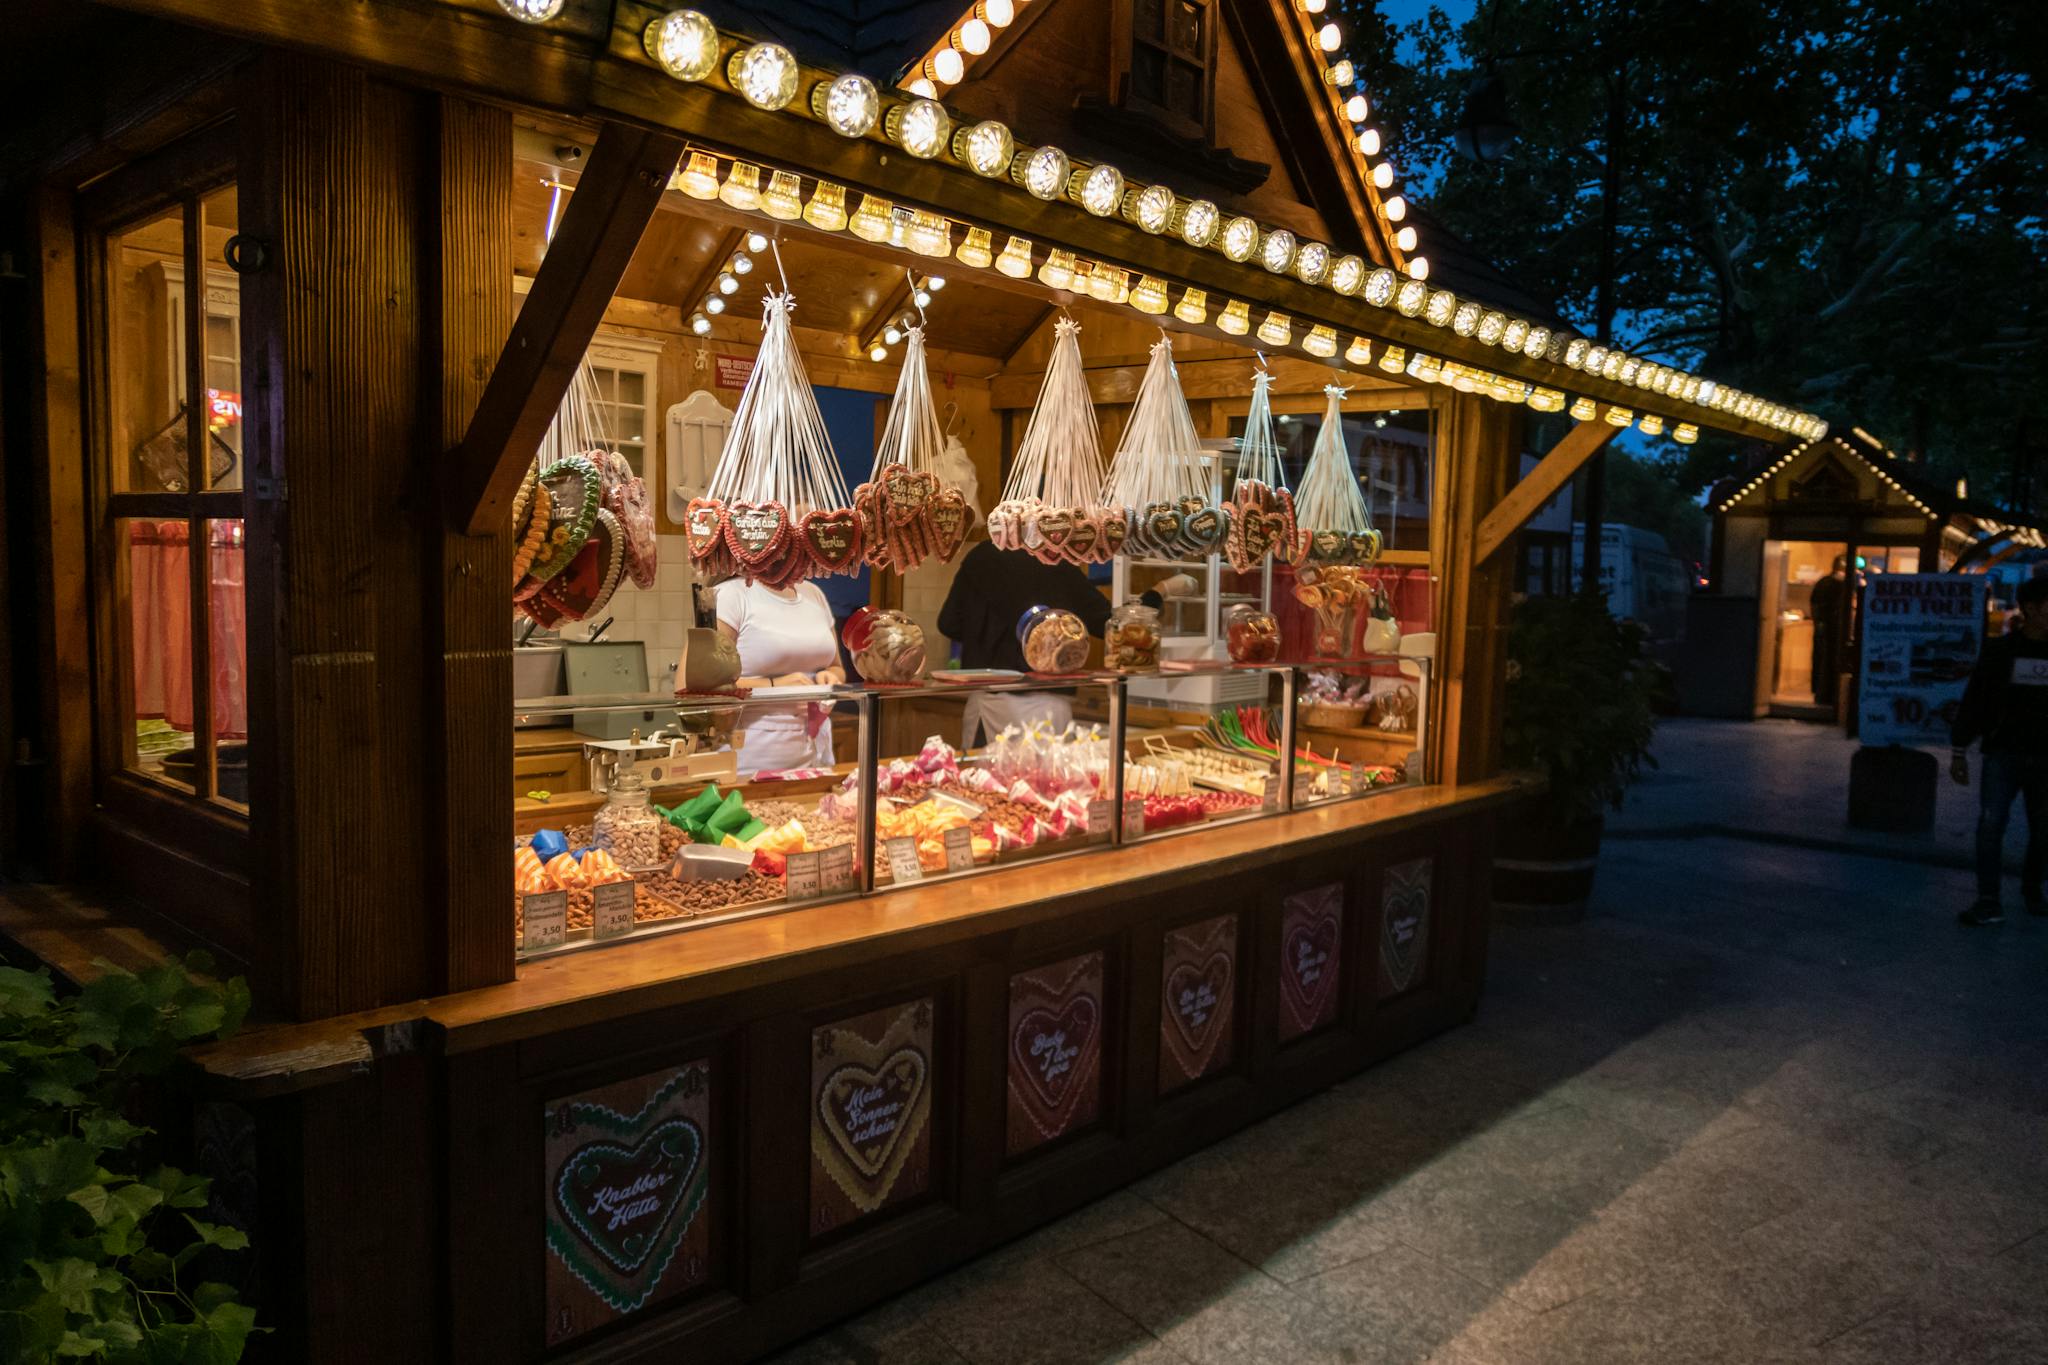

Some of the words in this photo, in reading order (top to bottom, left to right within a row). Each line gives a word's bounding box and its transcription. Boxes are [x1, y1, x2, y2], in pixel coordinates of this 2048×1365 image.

[819, 536, 846, 549] Berlin
[1875, 580, 1973, 596] BERLINER
[1870, 598, 1910, 614] CITY
[1919, 599, 1973, 615] TOUR
[844, 1087, 886, 1112] Mein
[852, 1118, 897, 1144] schein
[587, 1173, 674, 1216] Knabber-
[607, 1195, 662, 1231] Hütte
